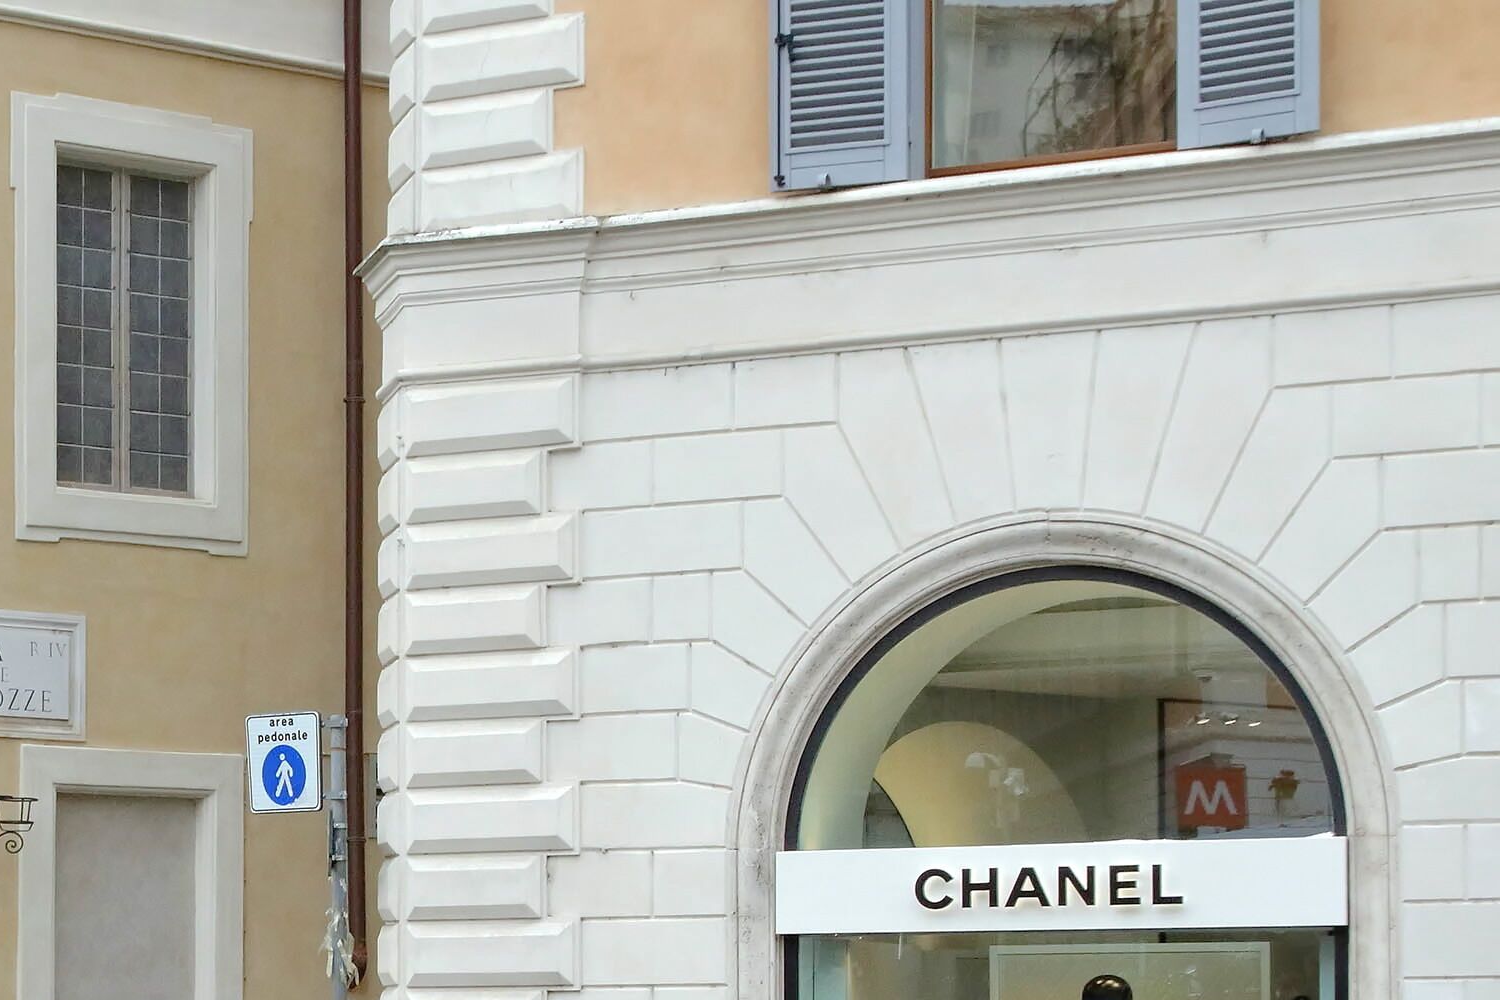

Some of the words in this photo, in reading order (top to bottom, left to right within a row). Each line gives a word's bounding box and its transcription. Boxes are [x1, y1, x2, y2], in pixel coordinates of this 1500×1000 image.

[269, 717, 294, 727] area
[257, 730, 308, 744] pedonale
[915, 864, 1184, 909] CHANEL
